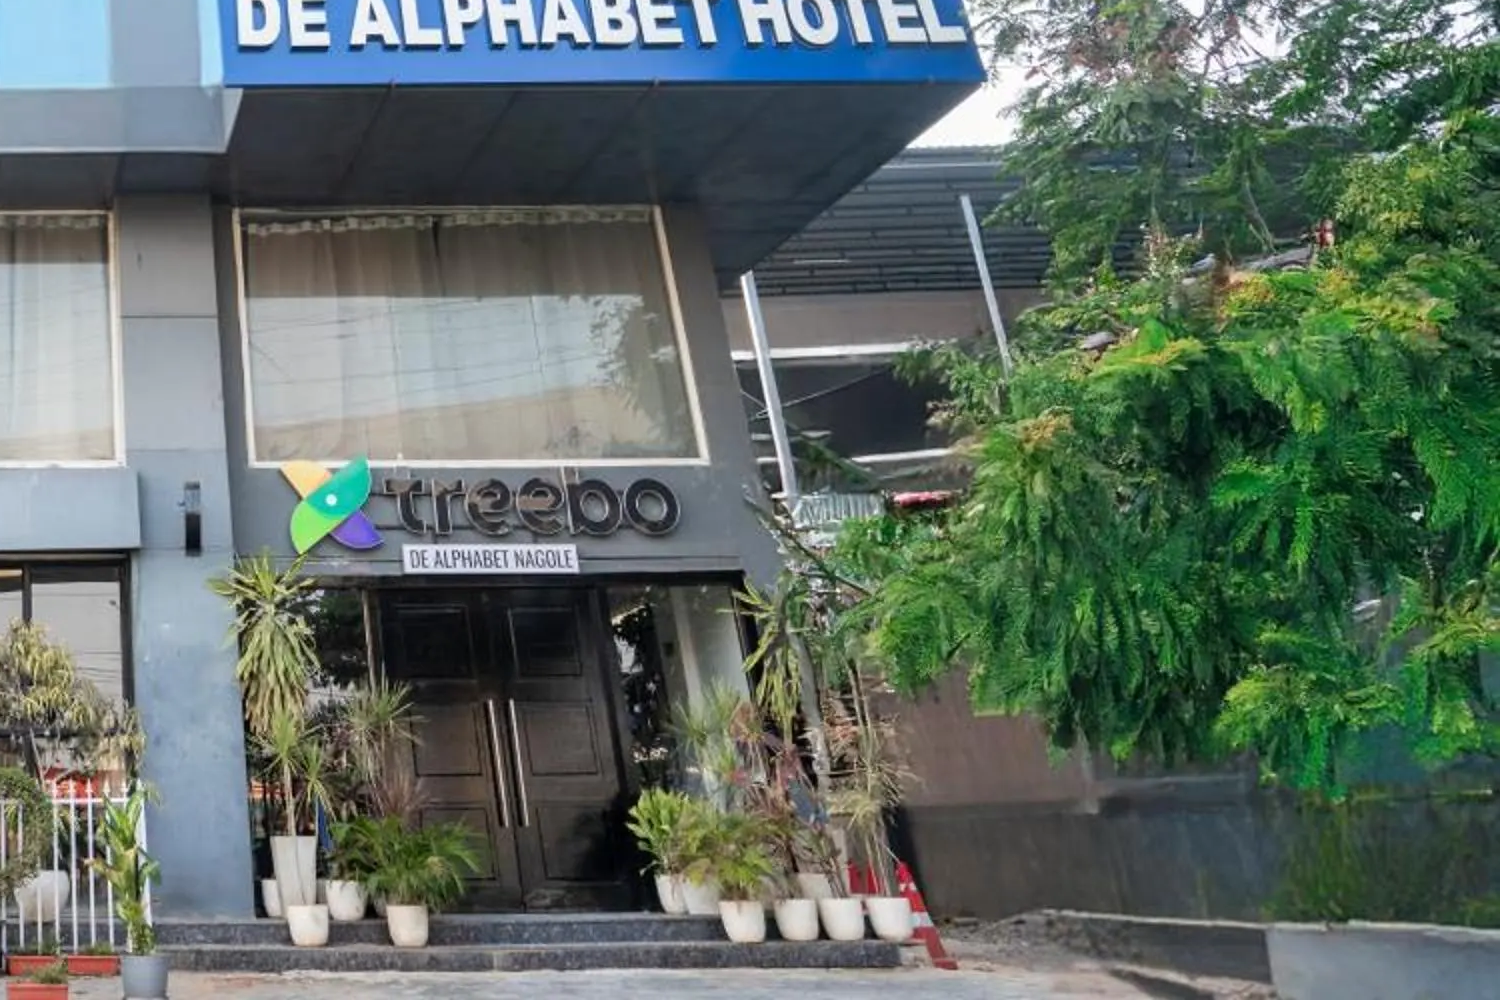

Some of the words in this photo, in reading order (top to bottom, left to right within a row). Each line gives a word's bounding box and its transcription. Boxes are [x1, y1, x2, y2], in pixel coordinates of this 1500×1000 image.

[384, 466, 682, 536] treebo
[410, 550, 430, 569] DE
[435, 549, 509, 569] ALPHABET
[515, 548, 574, 568] NAGOLE
